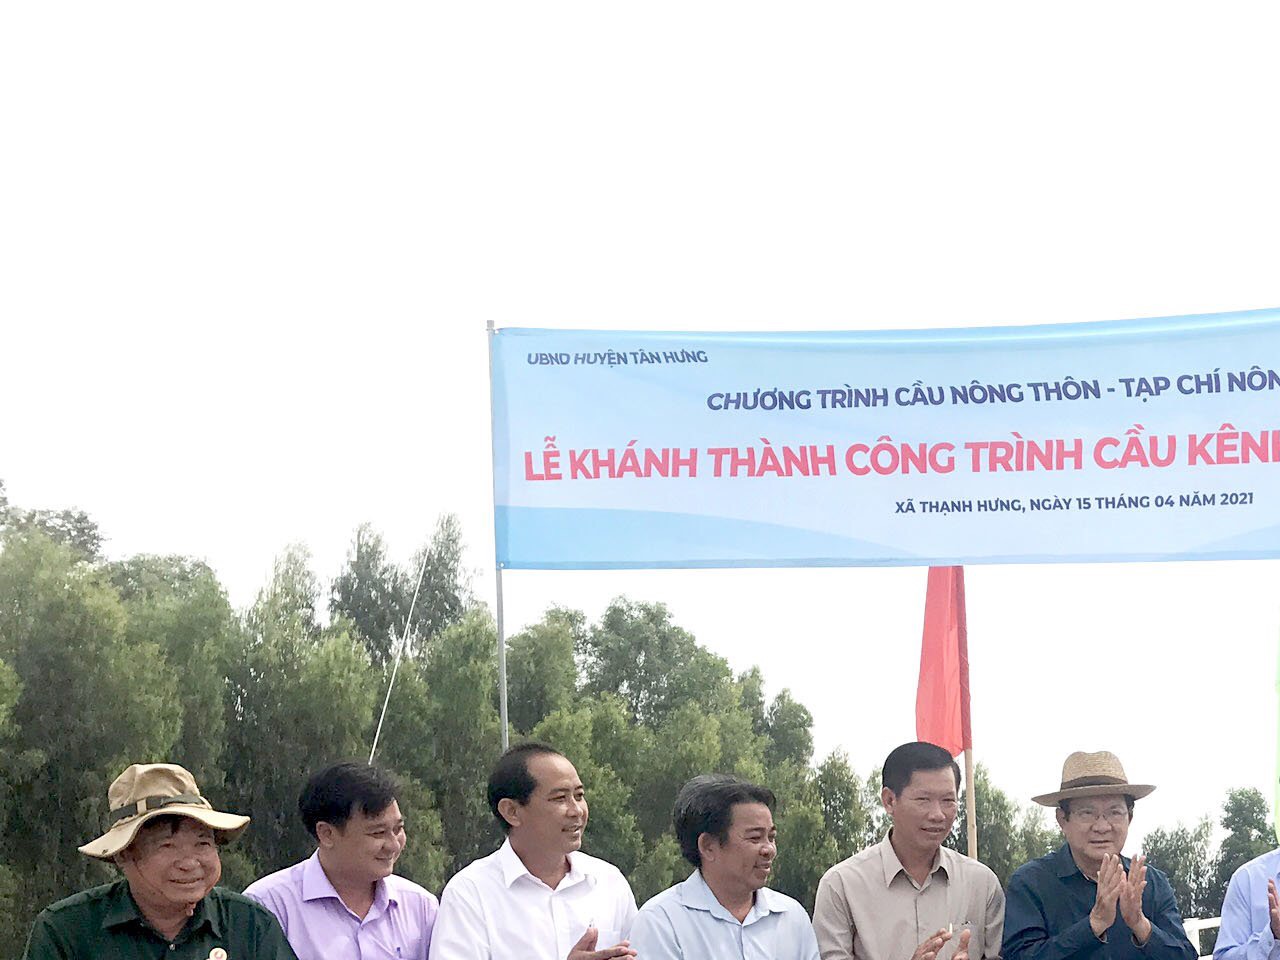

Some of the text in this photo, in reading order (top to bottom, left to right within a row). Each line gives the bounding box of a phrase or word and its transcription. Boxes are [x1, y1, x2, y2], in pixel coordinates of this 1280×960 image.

[527, 348, 708, 368] UBND HUYỆN TÂN HƯNG
[707, 387, 811, 411] CHƯƠNG
[816, 383, 889, 409] TRÌNH
[894, 380, 944, 406] CẦU
[950, 380, 1025, 405] NÔNG
[1027, 376, 1101, 401] THÔN
[1119, 376, 1171, 403] TẠP
[1176, 367, 1221, 395] CHÍ
[524, 435, 562, 481] LỄ
[569, 439, 698, 480] KHÁNH
[707, 437, 837, 478] THÀNH
[845, 435, 956, 476] CÔNG
[964, 431, 1083, 472] TRÌNH
[1093, 424, 1177, 470] CẦU
[895, 491, 1254, 516] XÃ THẠNH HƯNG, NGÀY 15 THÁNG 04 NĂM 2021
